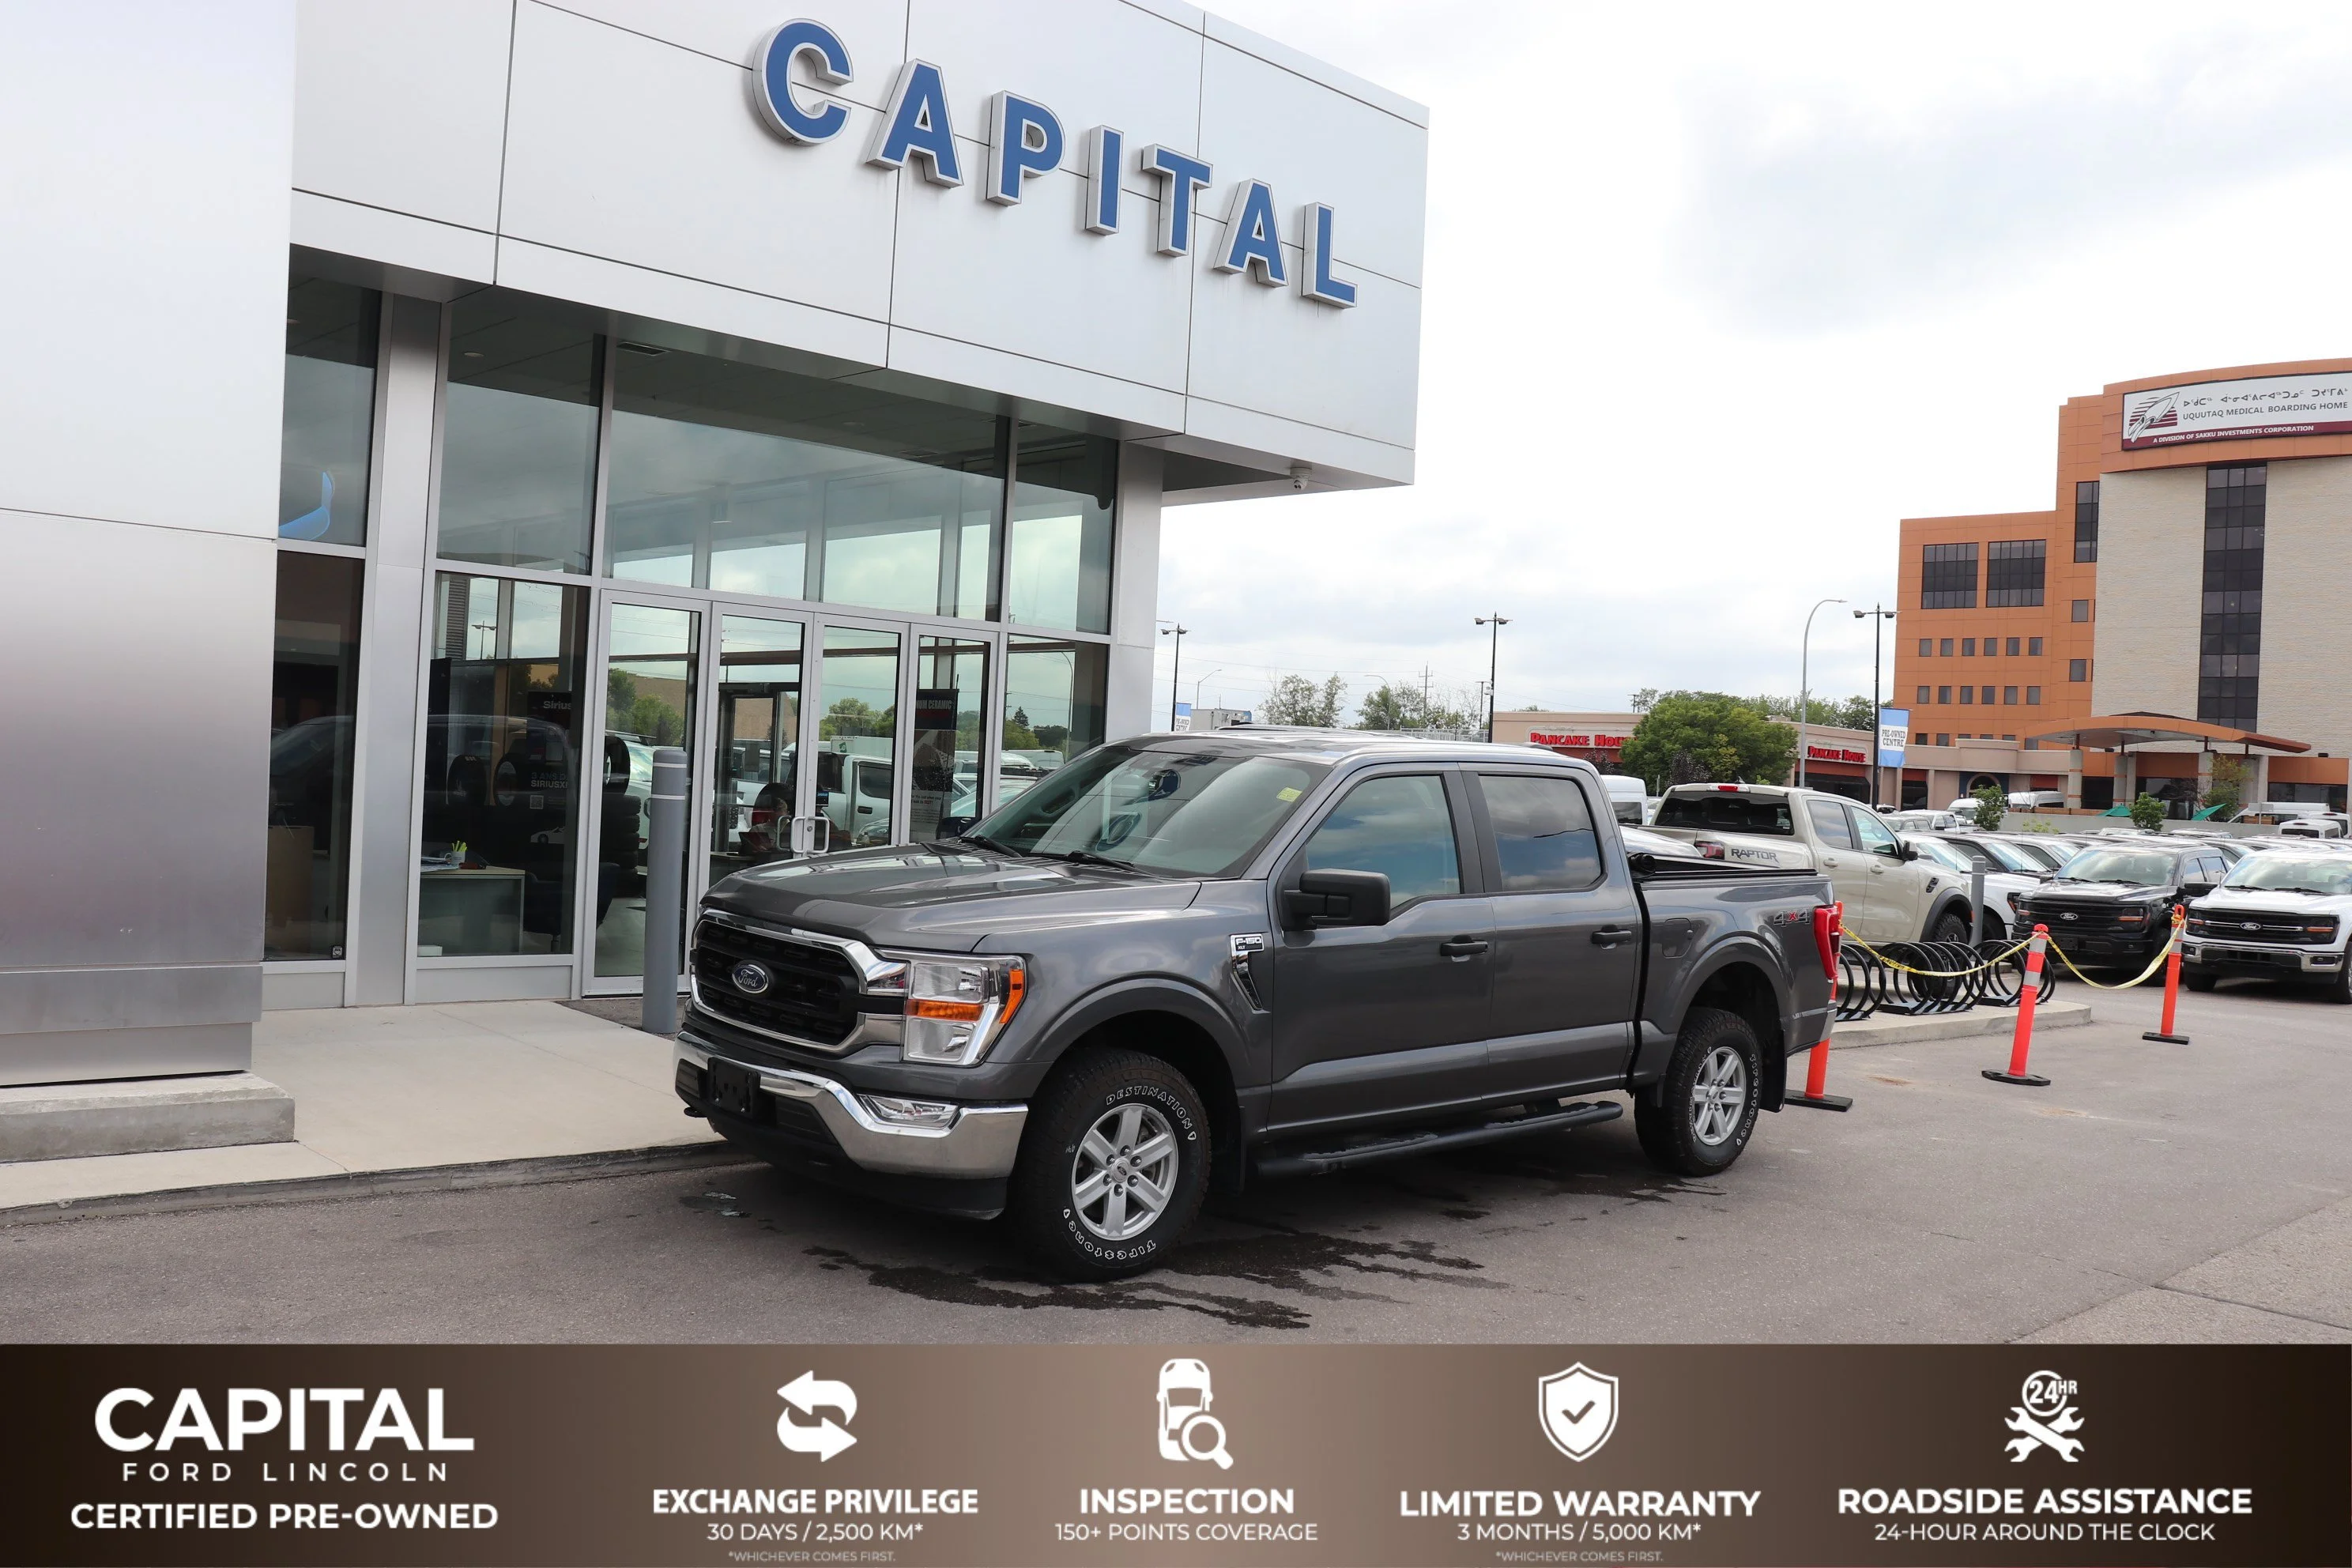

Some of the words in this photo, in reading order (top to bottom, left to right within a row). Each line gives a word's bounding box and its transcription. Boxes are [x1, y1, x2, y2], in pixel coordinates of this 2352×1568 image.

[752, 17, 1358, 308] CAPITAL
[2183, 409, 2224, 420] UQUUTAQ
[2226, 407, 2264, 416] MEDICAL
[2268, 403, 2316, 413] BOARDING
[2158, 434, 2184, 443] DIVISION
[2217, 428, 2262, 436] INVESTMENTS
[928, 699, 952, 710] CERAMIC
[1530, 733, 1590, 746] PANCAKE
[1881, 729, 1906, 739] PRE-OWNED
[1883, 737, 1905, 748] CENTRE
[1841, 749, 1866, 763] HOUSE
[1731, 848, 1779, 863] RAPTOR
[737, 968, 760, 987] Ford
[1106, 1085, 1193, 1130] DESTINATION
